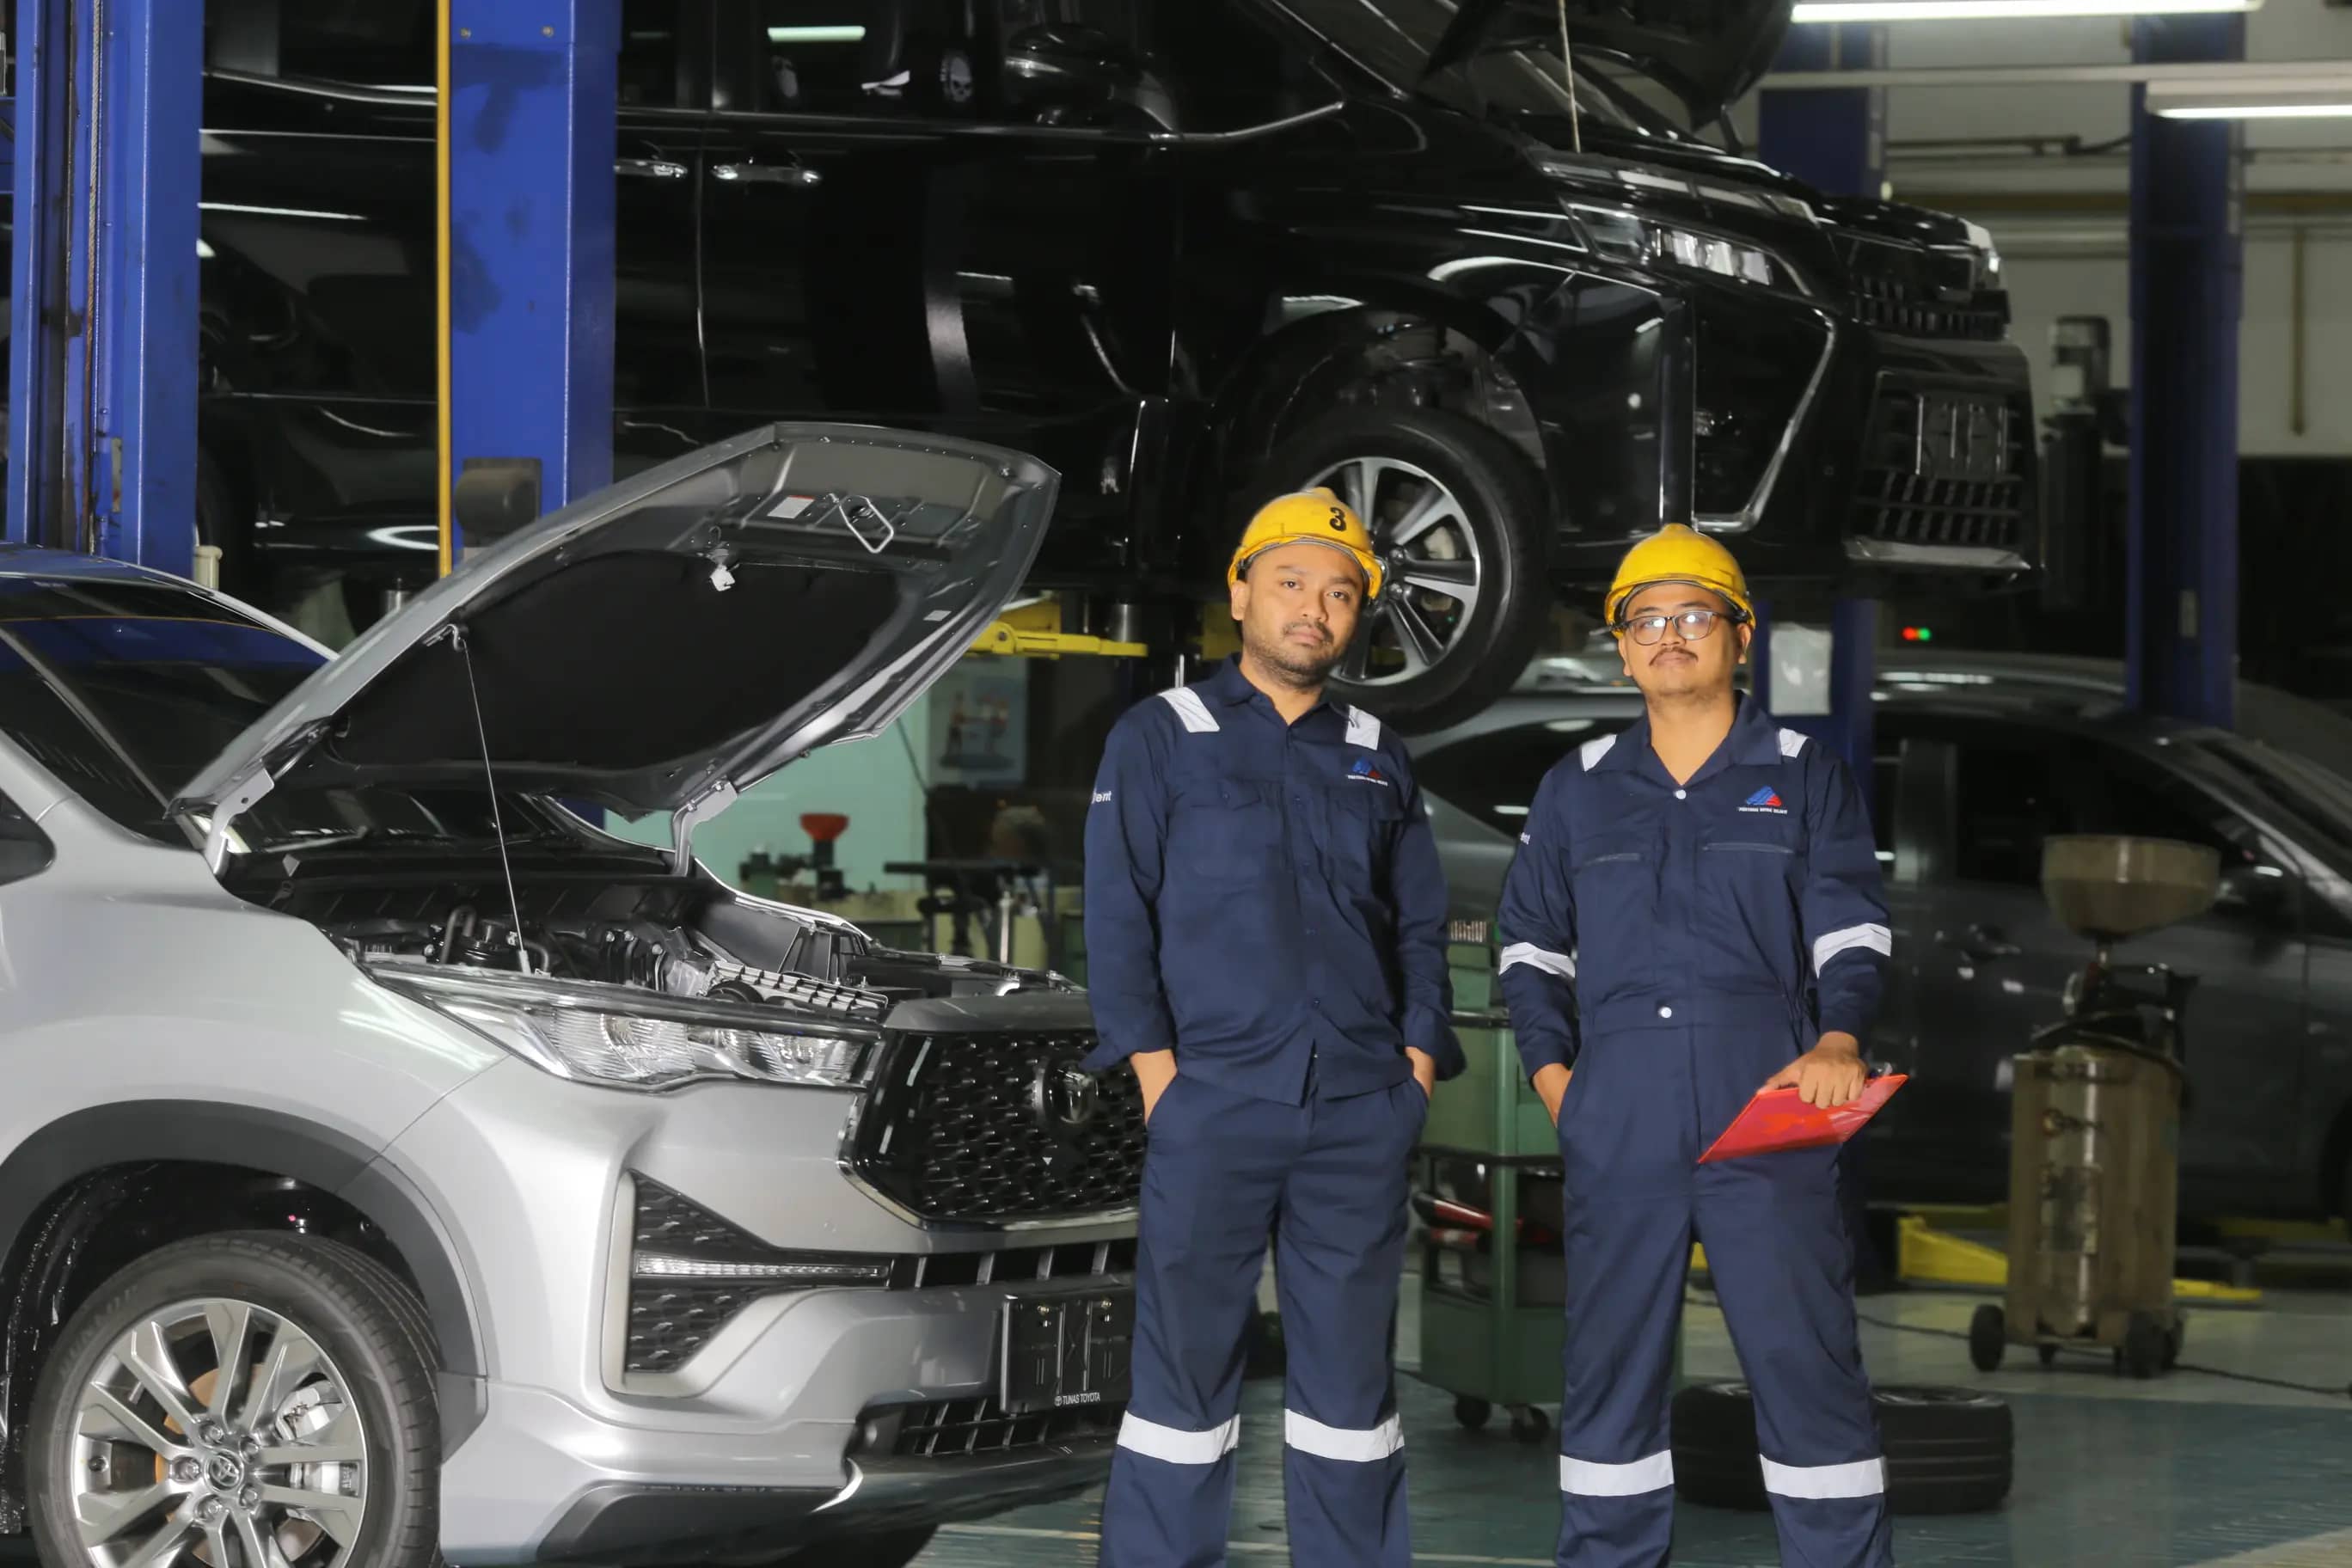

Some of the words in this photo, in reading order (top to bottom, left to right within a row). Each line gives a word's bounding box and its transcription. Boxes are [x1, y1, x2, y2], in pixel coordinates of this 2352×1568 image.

[1329, 507, 1347, 531] 3
[1063, 1394, 1080, 1405] TUNAS
[1080, 1392, 1100, 1403] TOYOTA
